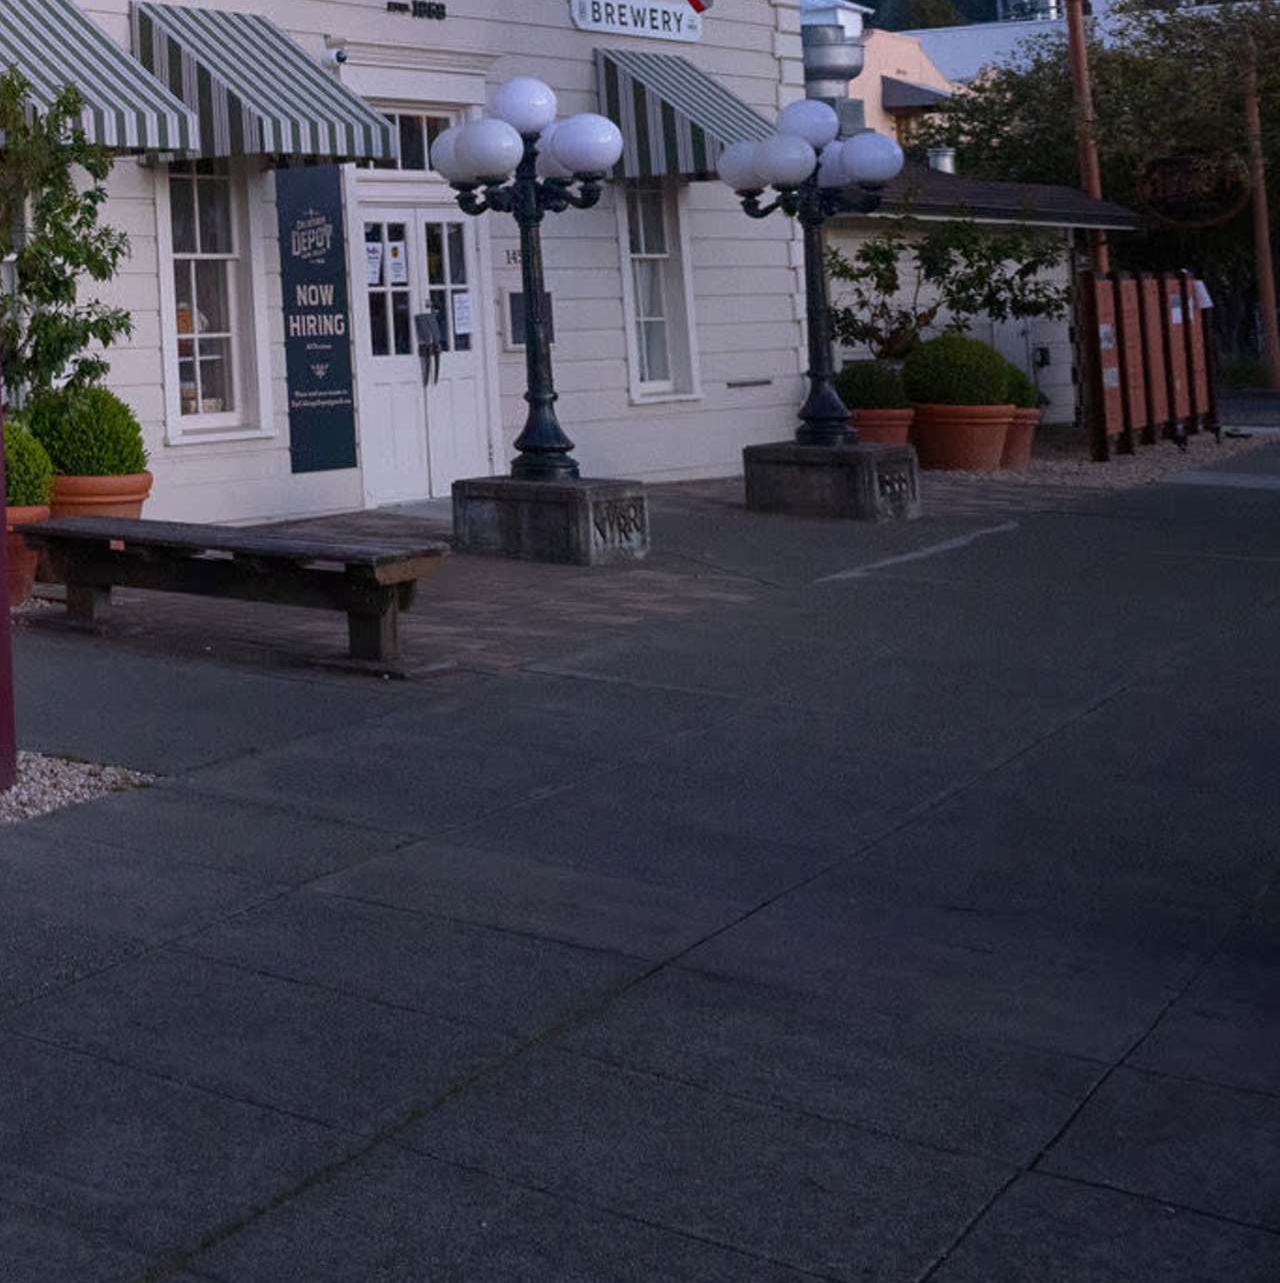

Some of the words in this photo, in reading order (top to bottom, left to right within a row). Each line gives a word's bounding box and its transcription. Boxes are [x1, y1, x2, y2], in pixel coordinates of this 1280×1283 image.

[591, 0, 684, 33] BREWERY
[291, 223, 334, 257] DEPOT
[296, 284, 335, 306] NOW
[288, 313, 346, 337] HIRING
